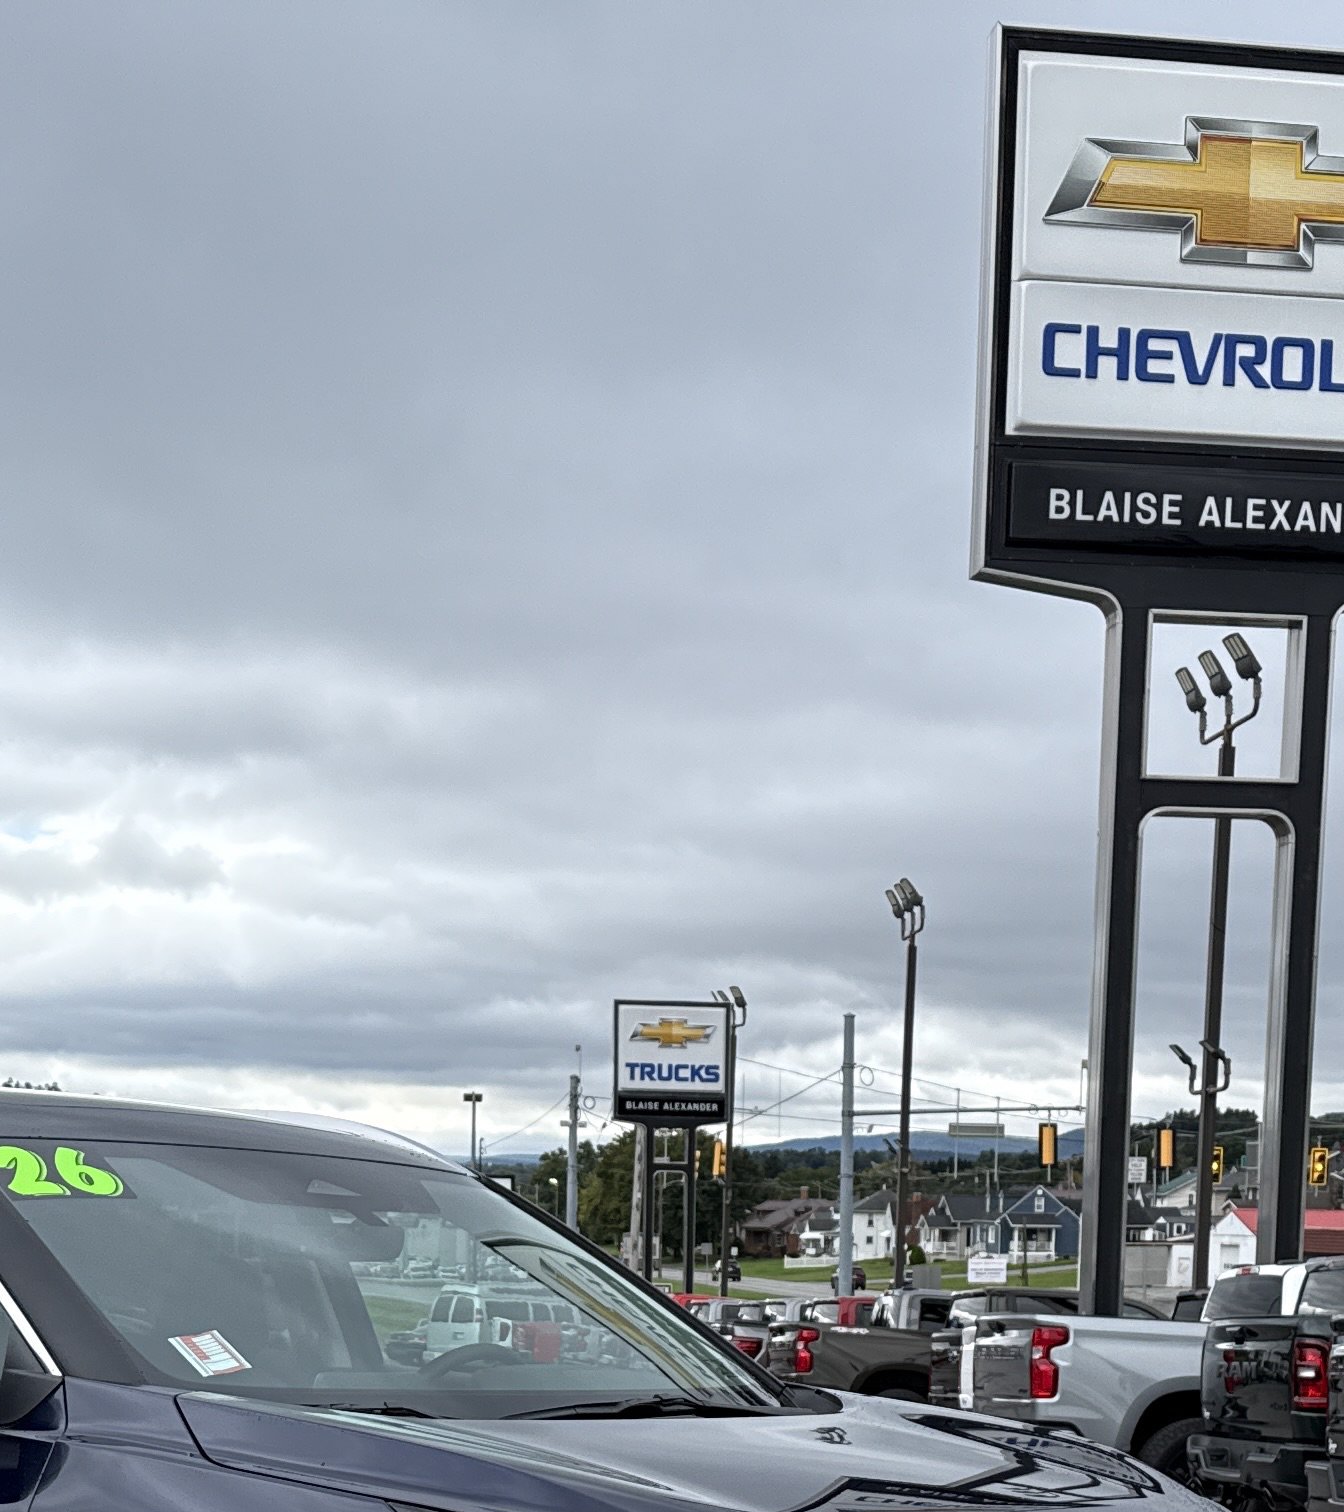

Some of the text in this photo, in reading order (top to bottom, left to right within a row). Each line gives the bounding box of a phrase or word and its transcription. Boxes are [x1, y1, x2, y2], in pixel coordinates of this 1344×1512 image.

[1047, 487, 1184, 527] BLAISE
[625, 1062, 720, 1082] TRUCKS
[625, 1100, 719, 1113] BLAISE ALEXANDER
[1217, 1361, 1258, 1378] RAM
